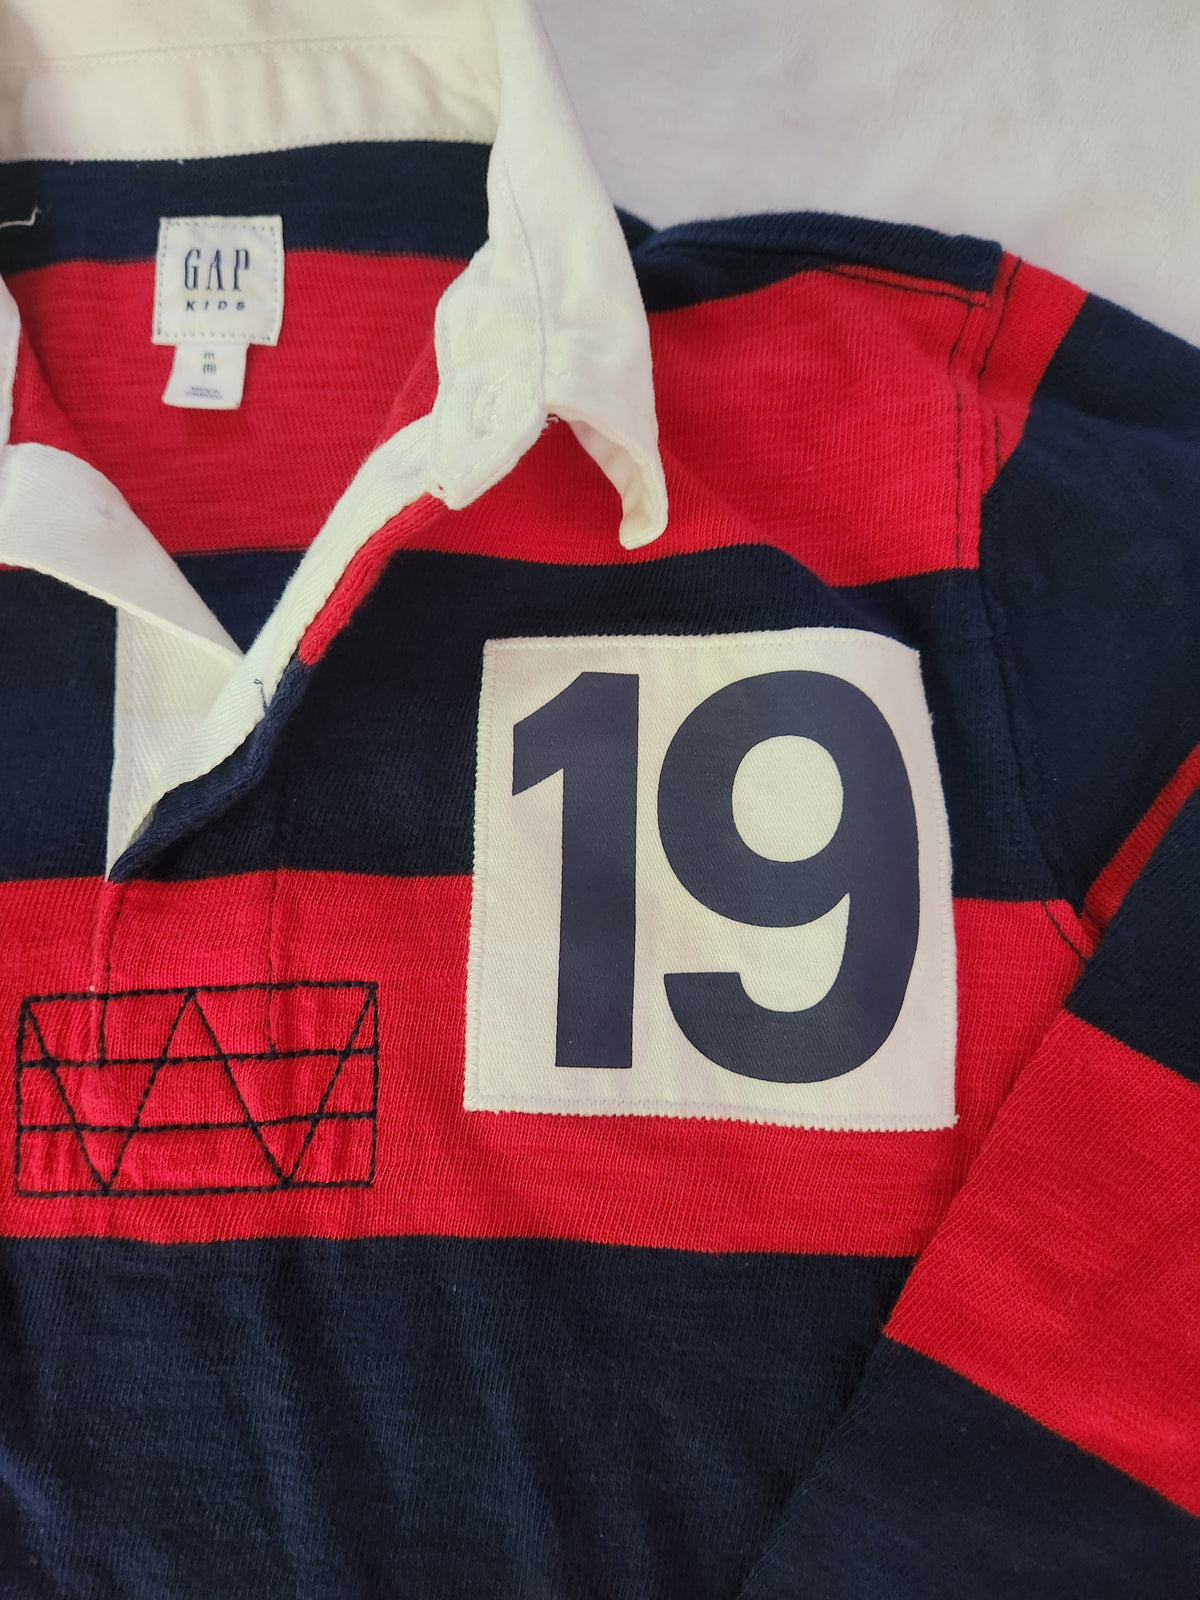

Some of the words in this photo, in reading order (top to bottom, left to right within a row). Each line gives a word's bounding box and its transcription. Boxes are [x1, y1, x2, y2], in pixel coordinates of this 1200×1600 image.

[184, 248, 250, 292] GAP
[186, 301, 245, 312] KIDS
[512, 670, 920, 1083] 19
